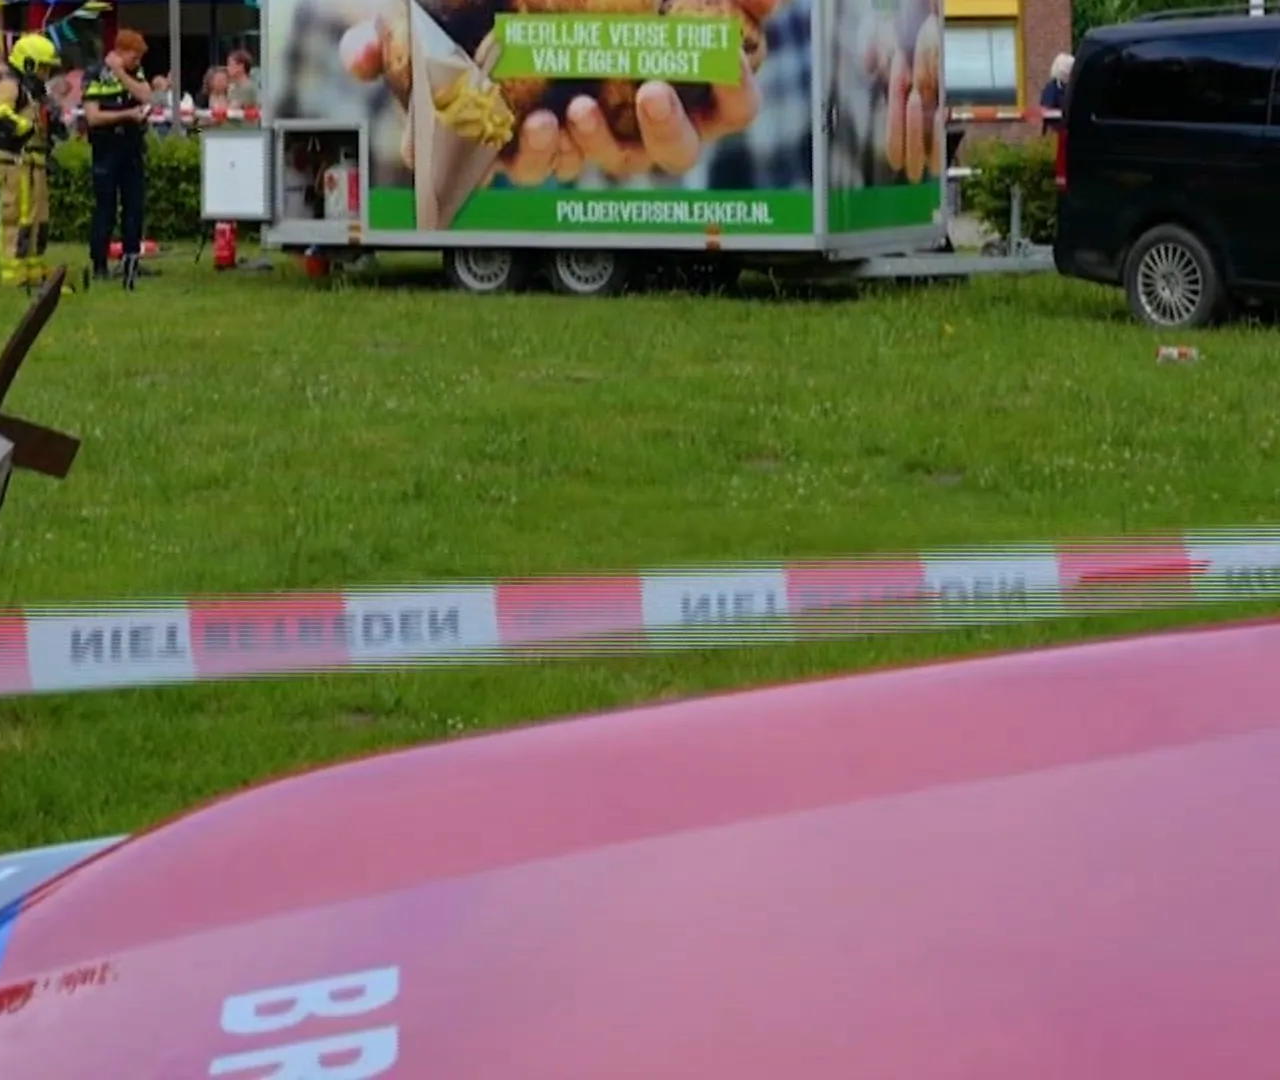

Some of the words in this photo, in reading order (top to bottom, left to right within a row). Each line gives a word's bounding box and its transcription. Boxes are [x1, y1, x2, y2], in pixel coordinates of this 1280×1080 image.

[505, 21, 602, 47] HEERLIJKE
[609, 23, 670, 48] VERSE
[676, 23, 729, 50] FRIET
[532, 47, 570, 72] VAN
[577, 50, 630, 72] EIGEN
[637, 50, 701, 74] OOGST
[557, 200, 773, 224] POLDERVERSENLEKKER.NL
